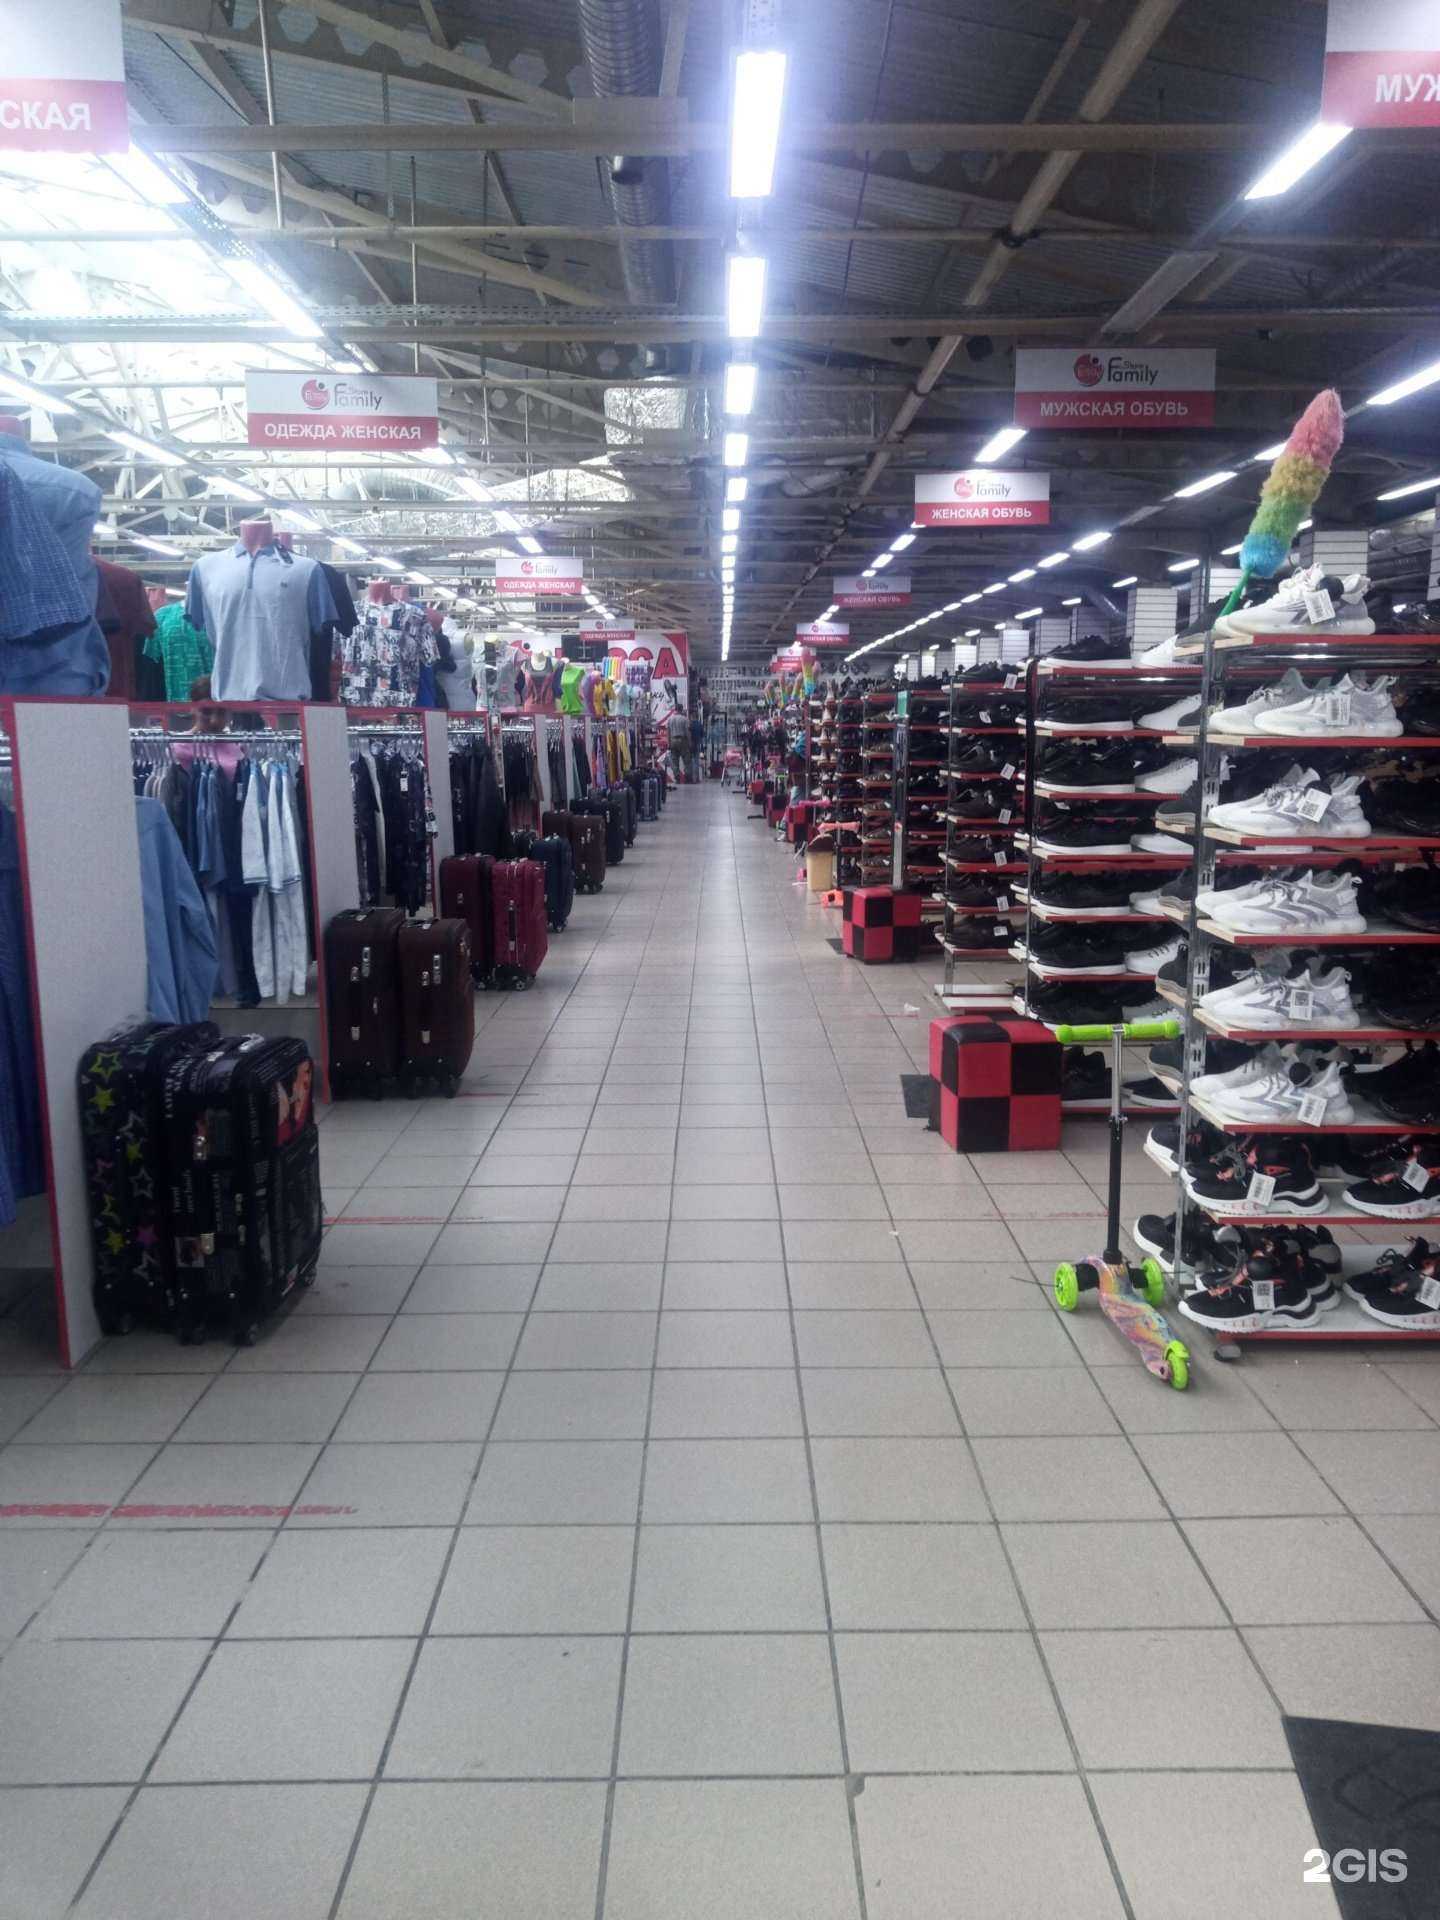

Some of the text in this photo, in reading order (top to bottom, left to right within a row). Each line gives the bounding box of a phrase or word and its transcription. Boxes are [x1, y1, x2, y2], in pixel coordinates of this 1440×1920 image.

[0, 100, 92, 131] СКАЯ
[1040, 401, 1188, 417] МУЖСКАЯ ОБУВЬ
[264, 423, 422, 440] ОДЕЖДА ЖЕНСКАЯ
[931, 507, 1032, 519] ЖЕНСКАЯ ОБУВЬ
